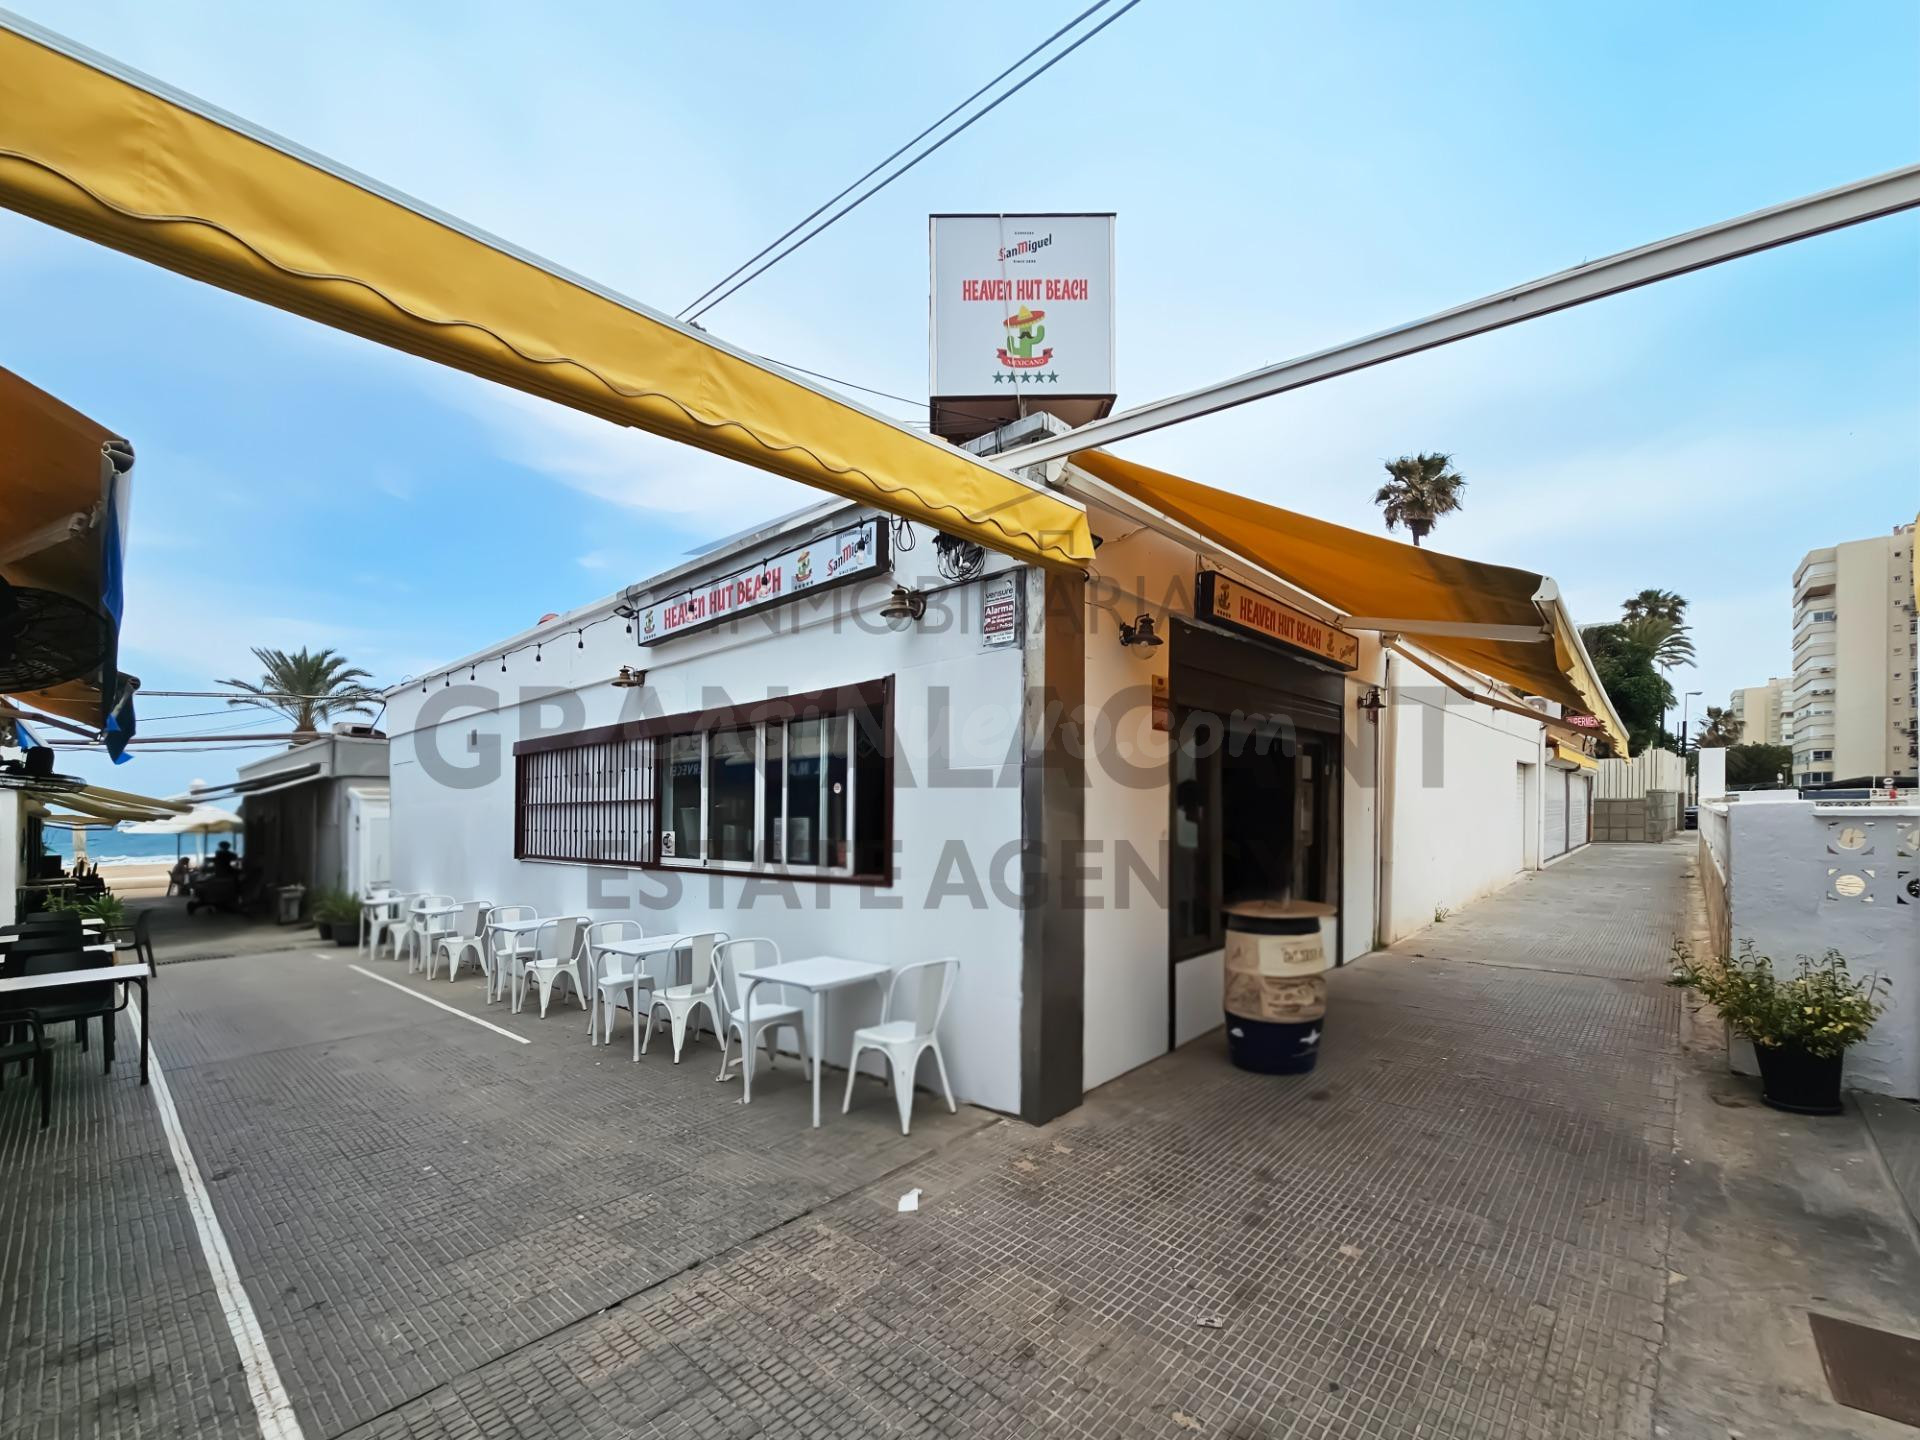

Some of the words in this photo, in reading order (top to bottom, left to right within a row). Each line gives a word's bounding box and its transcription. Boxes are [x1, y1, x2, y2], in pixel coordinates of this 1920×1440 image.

[1017, 279, 1042, 300] HUT
[1046, 279, 1088, 300] BEACH
[709, 585, 734, 614] HUT
[985, 604, 1014, 616] Alarma
[1279, 613, 1296, 639] HUT
[1297, 621, 1322, 649] BEACH
